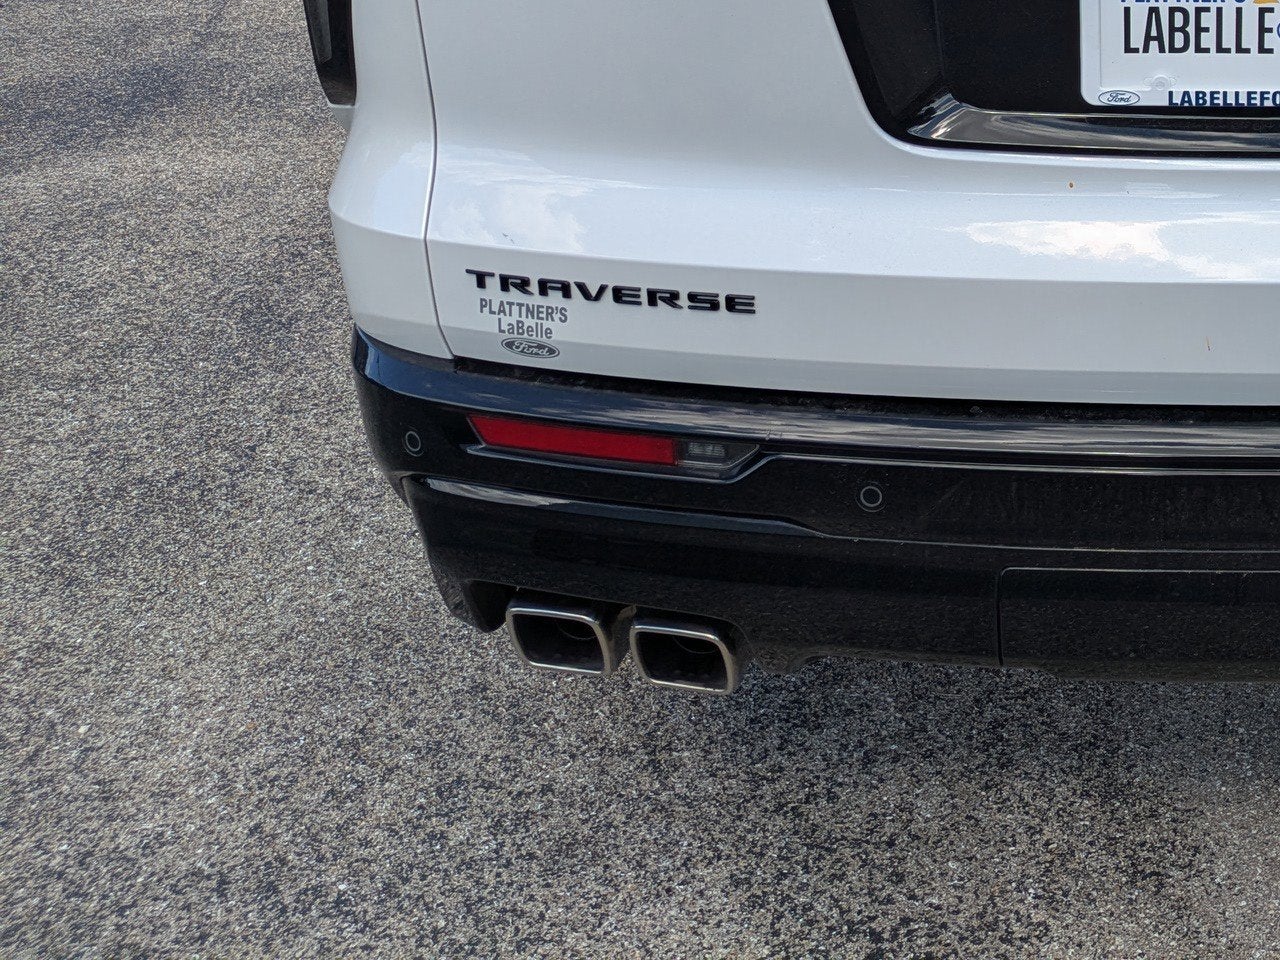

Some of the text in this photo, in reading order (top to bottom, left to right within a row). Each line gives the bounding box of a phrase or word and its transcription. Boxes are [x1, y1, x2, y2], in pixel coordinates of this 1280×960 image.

[1123, 6, 1275, 55] LABELLE
[465, 268, 756, 314] TRAVERSE
[479, 297, 568, 324] PLATTNER'S
[498, 317, 553, 340] LaBelle
